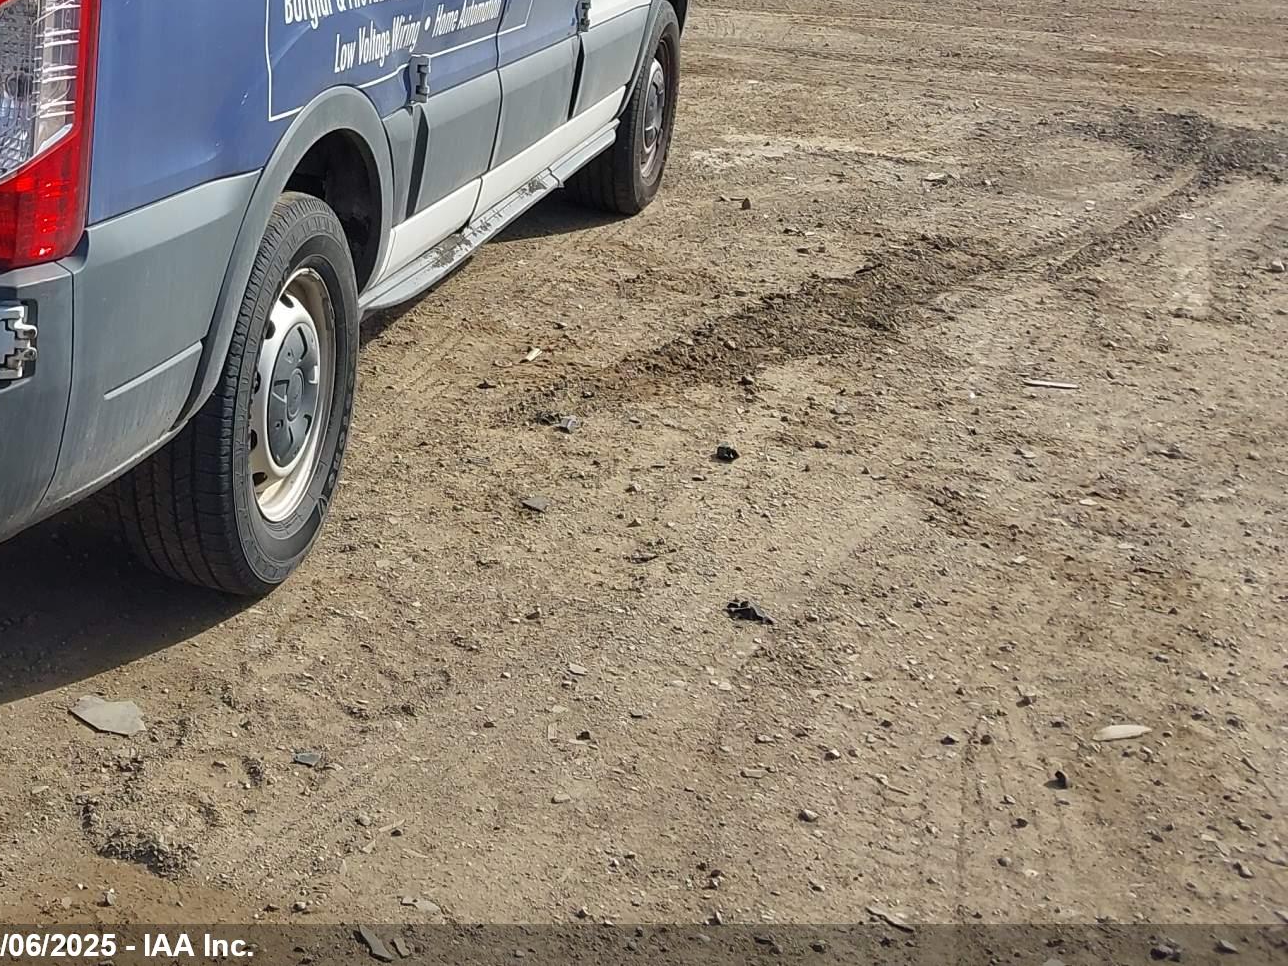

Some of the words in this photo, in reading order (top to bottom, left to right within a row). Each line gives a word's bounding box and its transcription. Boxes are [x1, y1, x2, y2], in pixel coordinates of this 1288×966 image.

[334, 34, 356, 73] Low
[358, 20, 391, 67] Voltage
[392, 15, 421, 52] Wiring
[432, 4, 459, 38] Home
